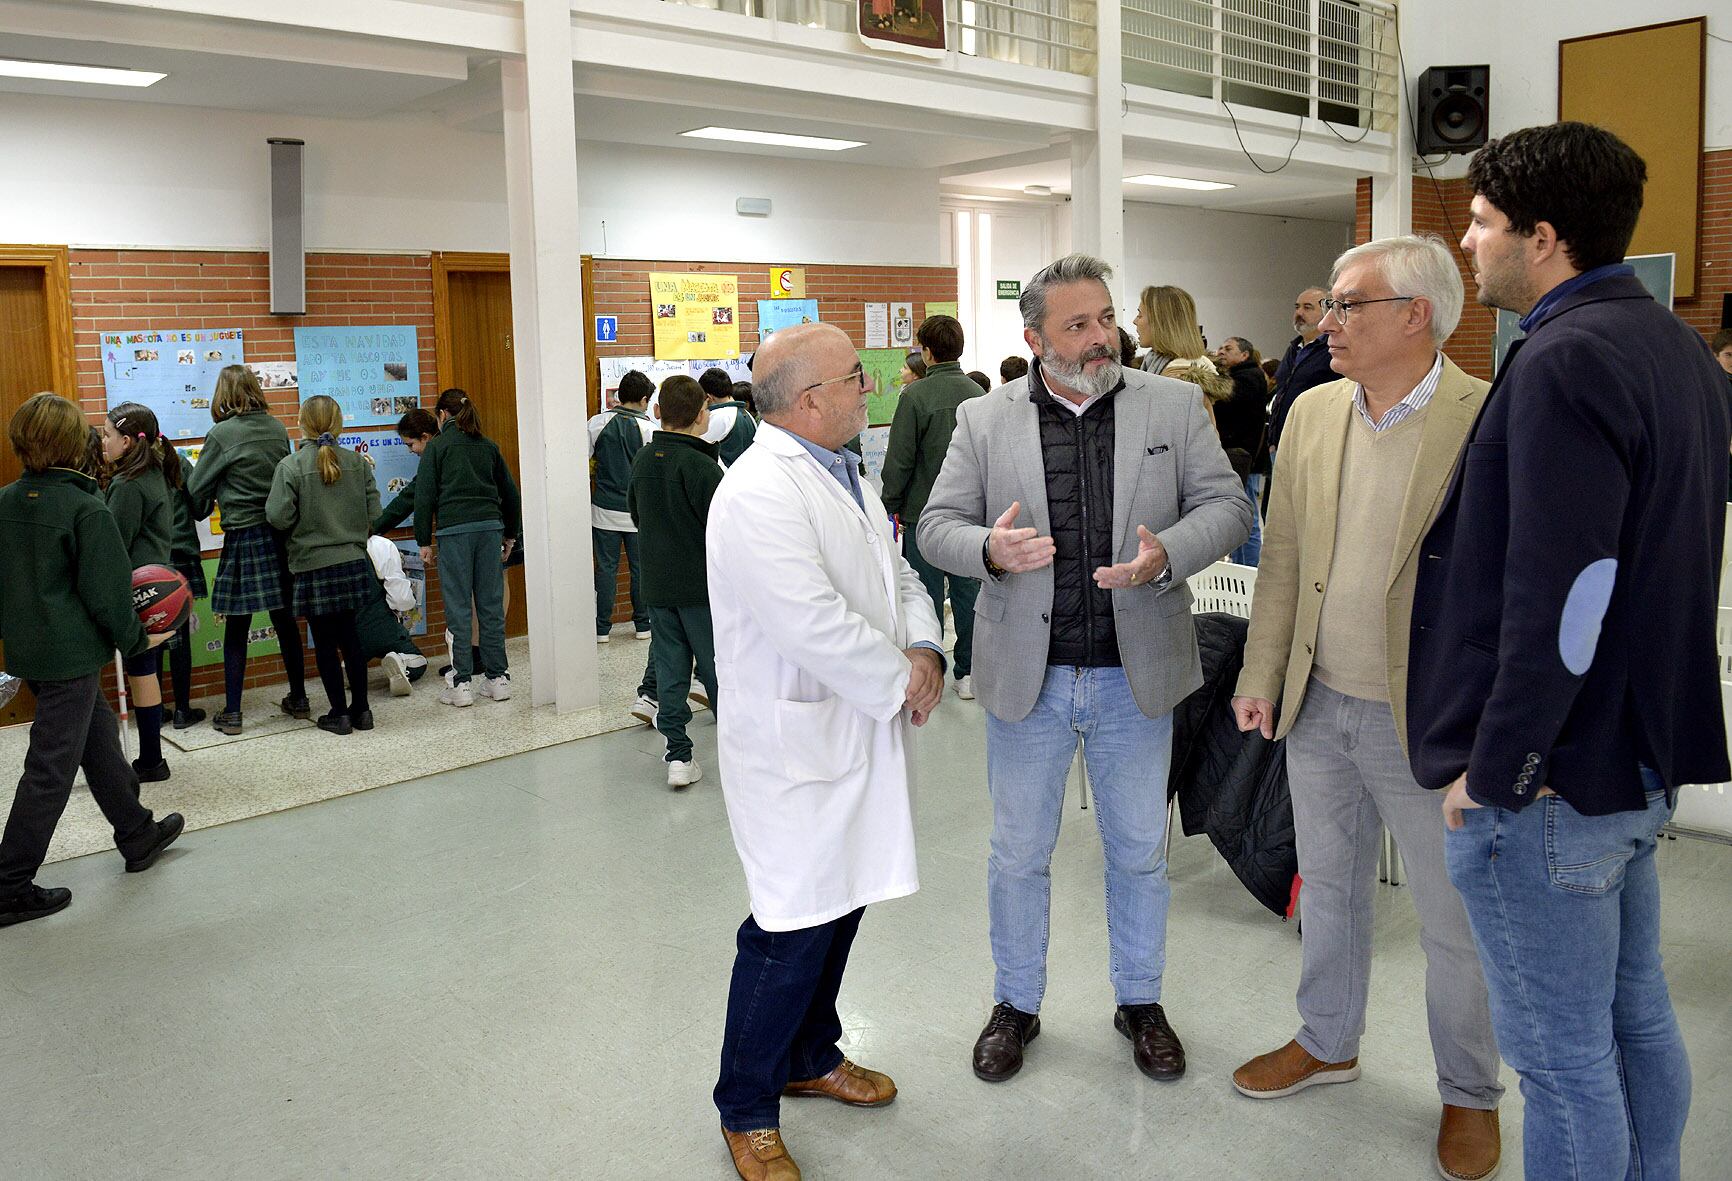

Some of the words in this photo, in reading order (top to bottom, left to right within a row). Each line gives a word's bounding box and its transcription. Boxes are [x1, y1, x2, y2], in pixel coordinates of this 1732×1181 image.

[105, 335, 122, 345] UNA
[126, 333, 163, 345] MASCOTA
[166, 334, 178, 343] NO
[181, 332, 192, 342] ES
[195, 333, 206, 343] UN
[209, 330, 243, 342] JUGUETE
[302, 335, 339, 349] ESTA
[345, 333, 407, 349] NAVIDAD
[337, 437, 362, 445] SCOTA
[369, 439, 380, 447] ES
[382, 438, 393, 447] UN
[132, 587, 159, 604] MAK
